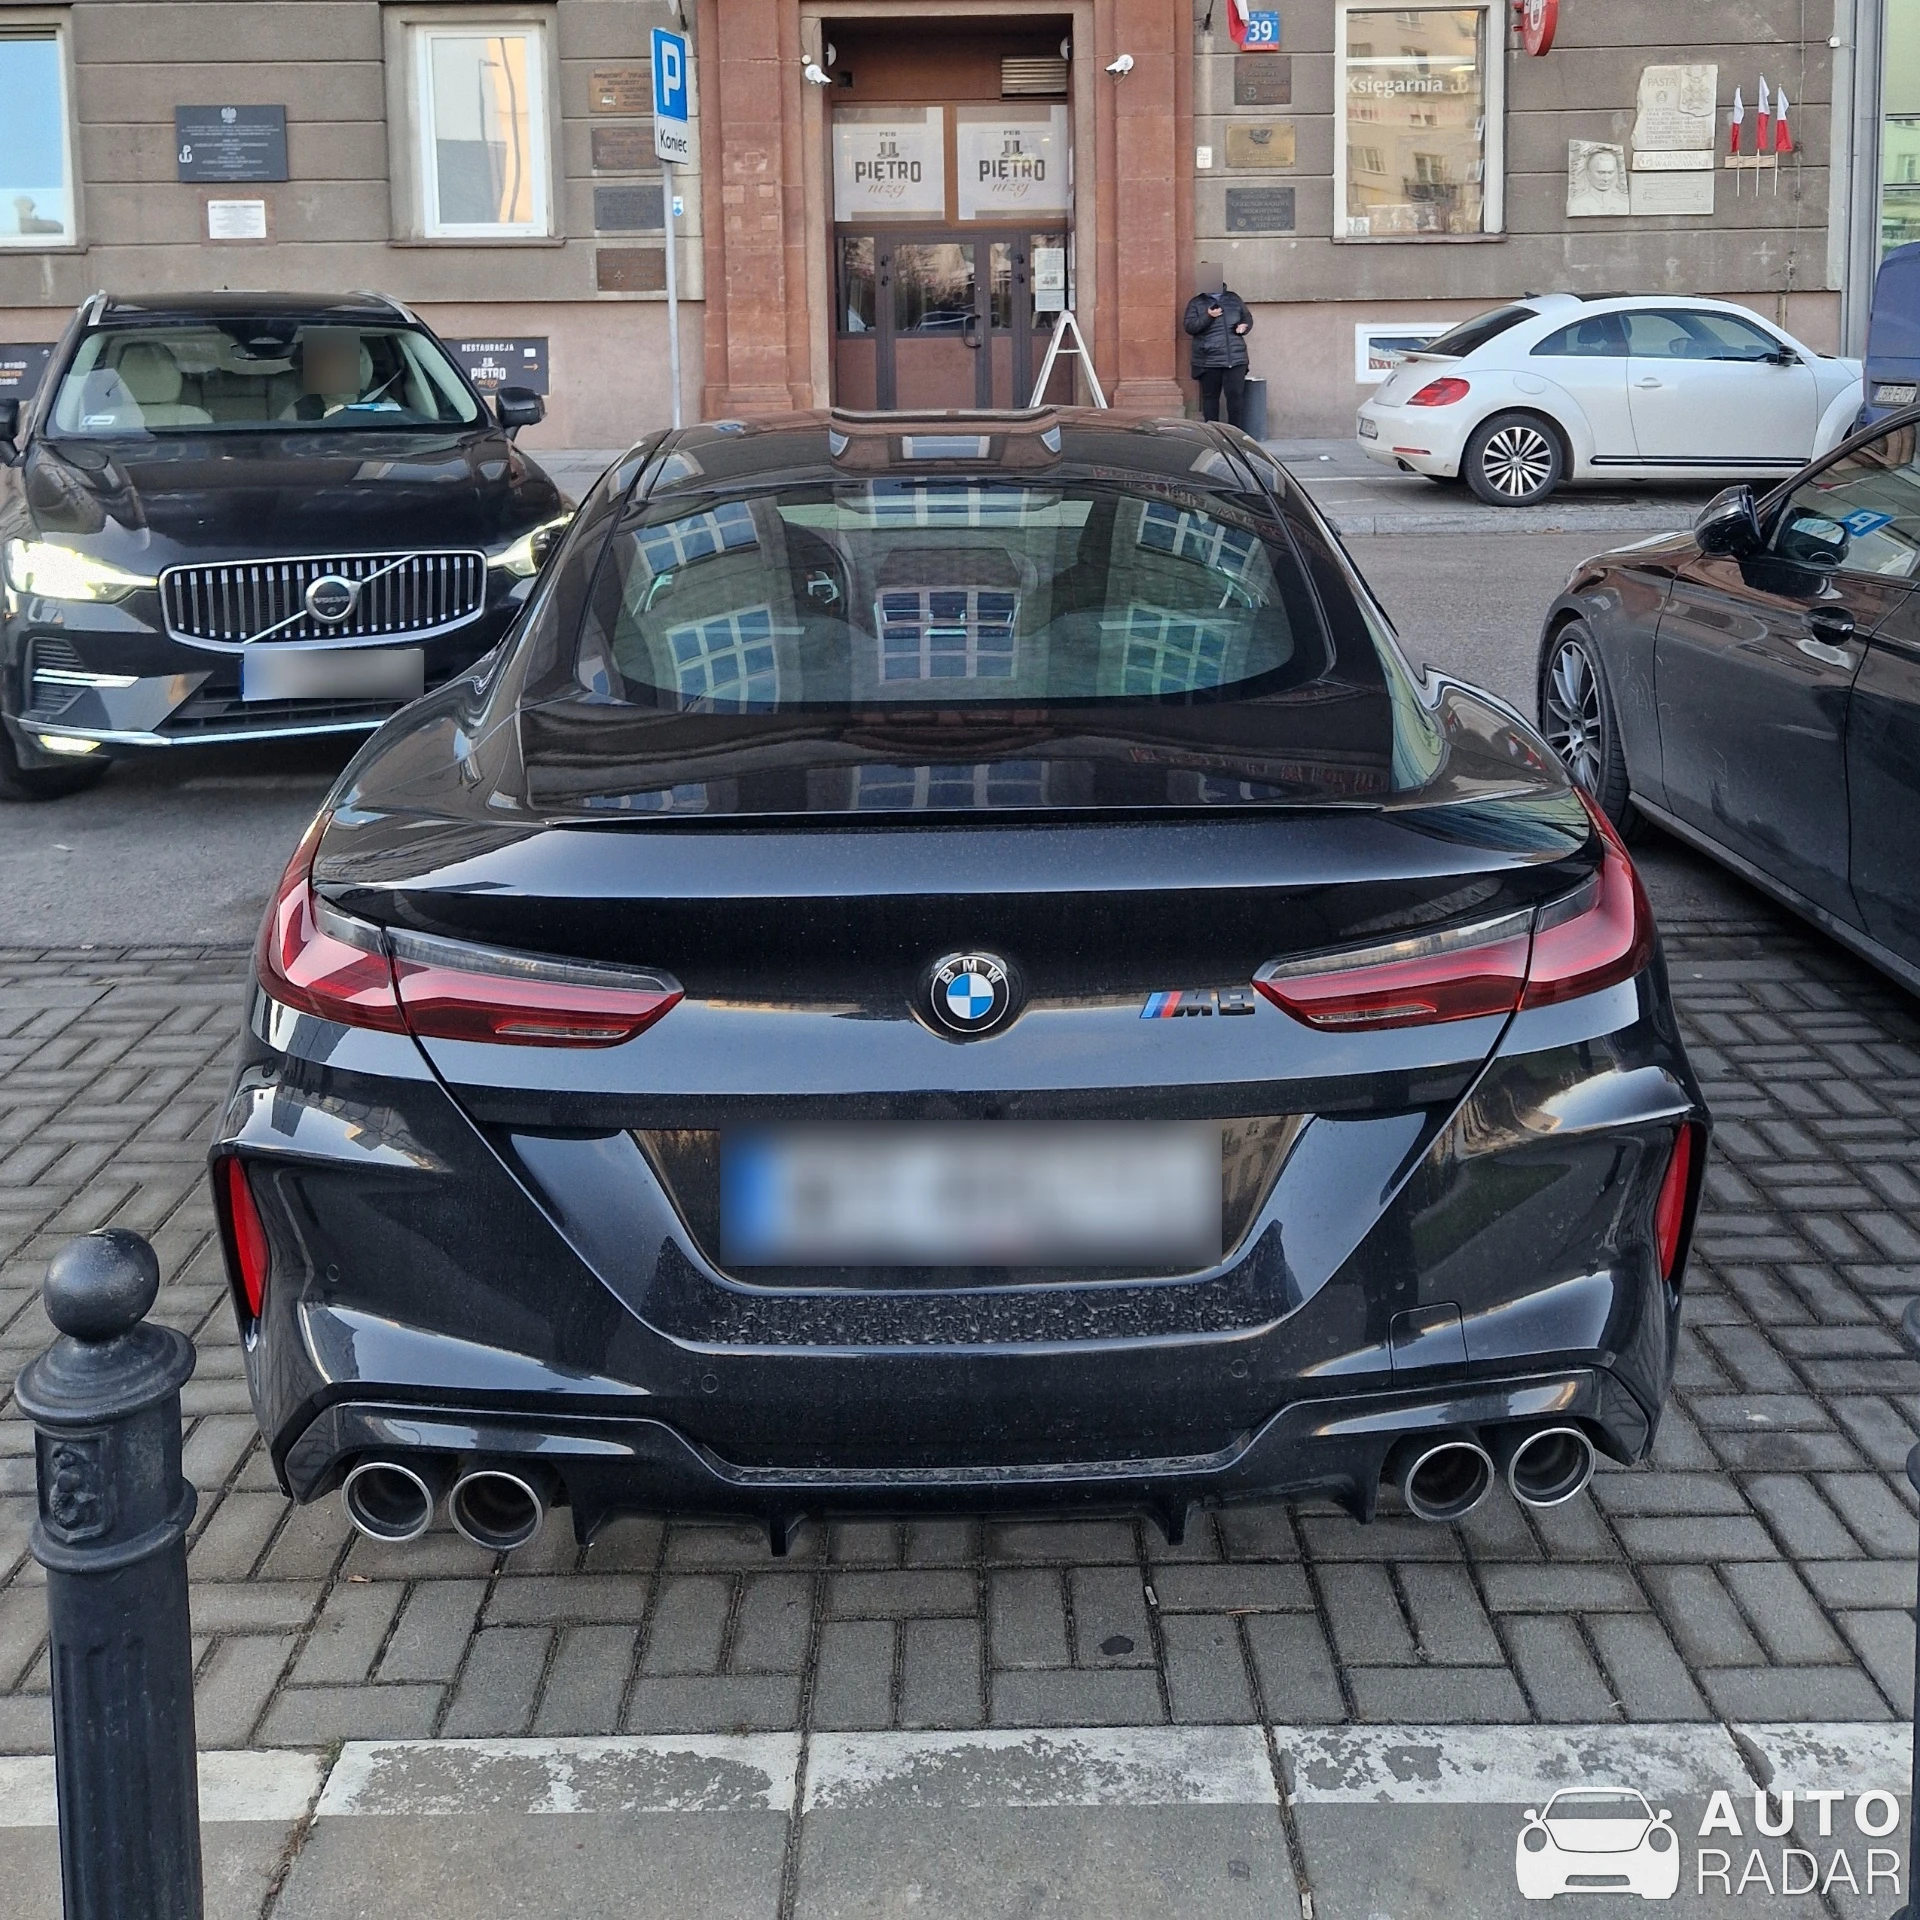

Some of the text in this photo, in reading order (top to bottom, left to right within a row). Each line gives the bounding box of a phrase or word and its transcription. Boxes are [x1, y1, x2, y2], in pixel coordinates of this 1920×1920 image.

[1249, 20, 1273, 41] 39
[661, 40, 681, 107] P
[1647, 78, 1677, 87] PASTA
[1346, 75, 1443, 98] Księgarnia
[660, 128, 687, 154] Koniec
[855, 161, 922, 183] PIĘTRO
[979, 159, 1045, 182] PIĘTRO
[461, 343, 515, 353] RESTAURACJA
[313, 595, 350, 604] VOLVO
[939, 959, 1003, 985] BMW
